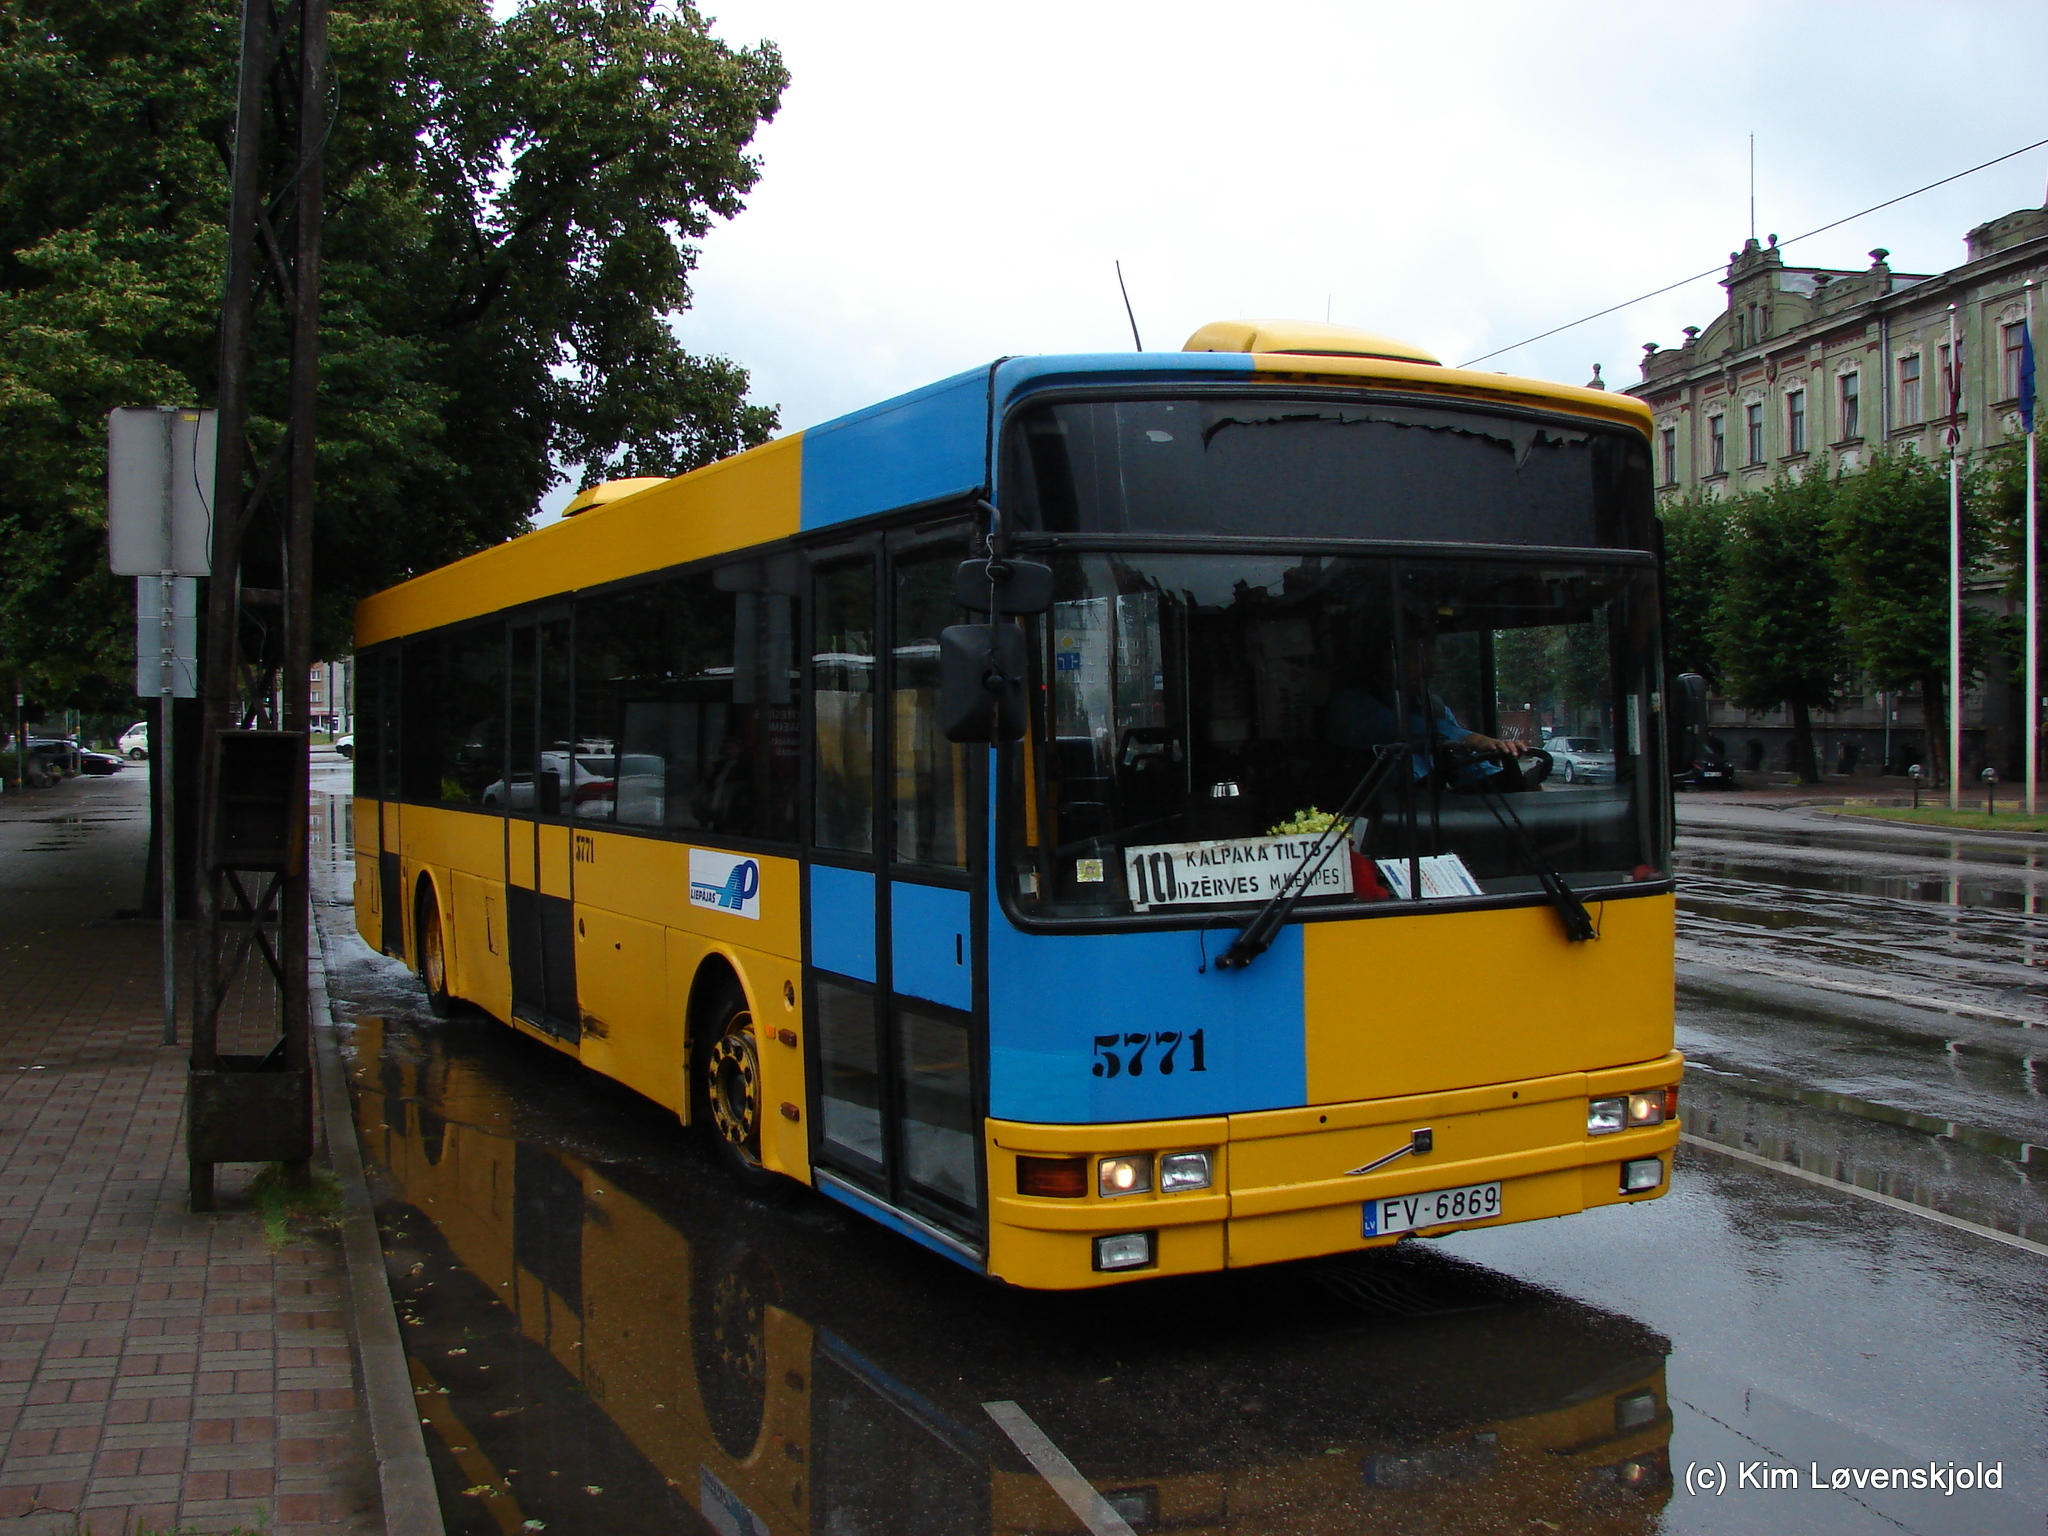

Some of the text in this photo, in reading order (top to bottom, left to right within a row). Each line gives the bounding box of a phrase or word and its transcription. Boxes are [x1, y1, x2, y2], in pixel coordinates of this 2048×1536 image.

[577, 835, 595, 864] 5771
[1186, 844, 1269, 868] KALPAKA
[1274, 841, 1322, 862] TILTS
[1133, 852, 1177, 905] 10
[1178, 876, 1260, 900] DZĒRVES
[1092, 1028, 1207, 1079] 5771
[1364, 1221, 1376, 1231] LV
